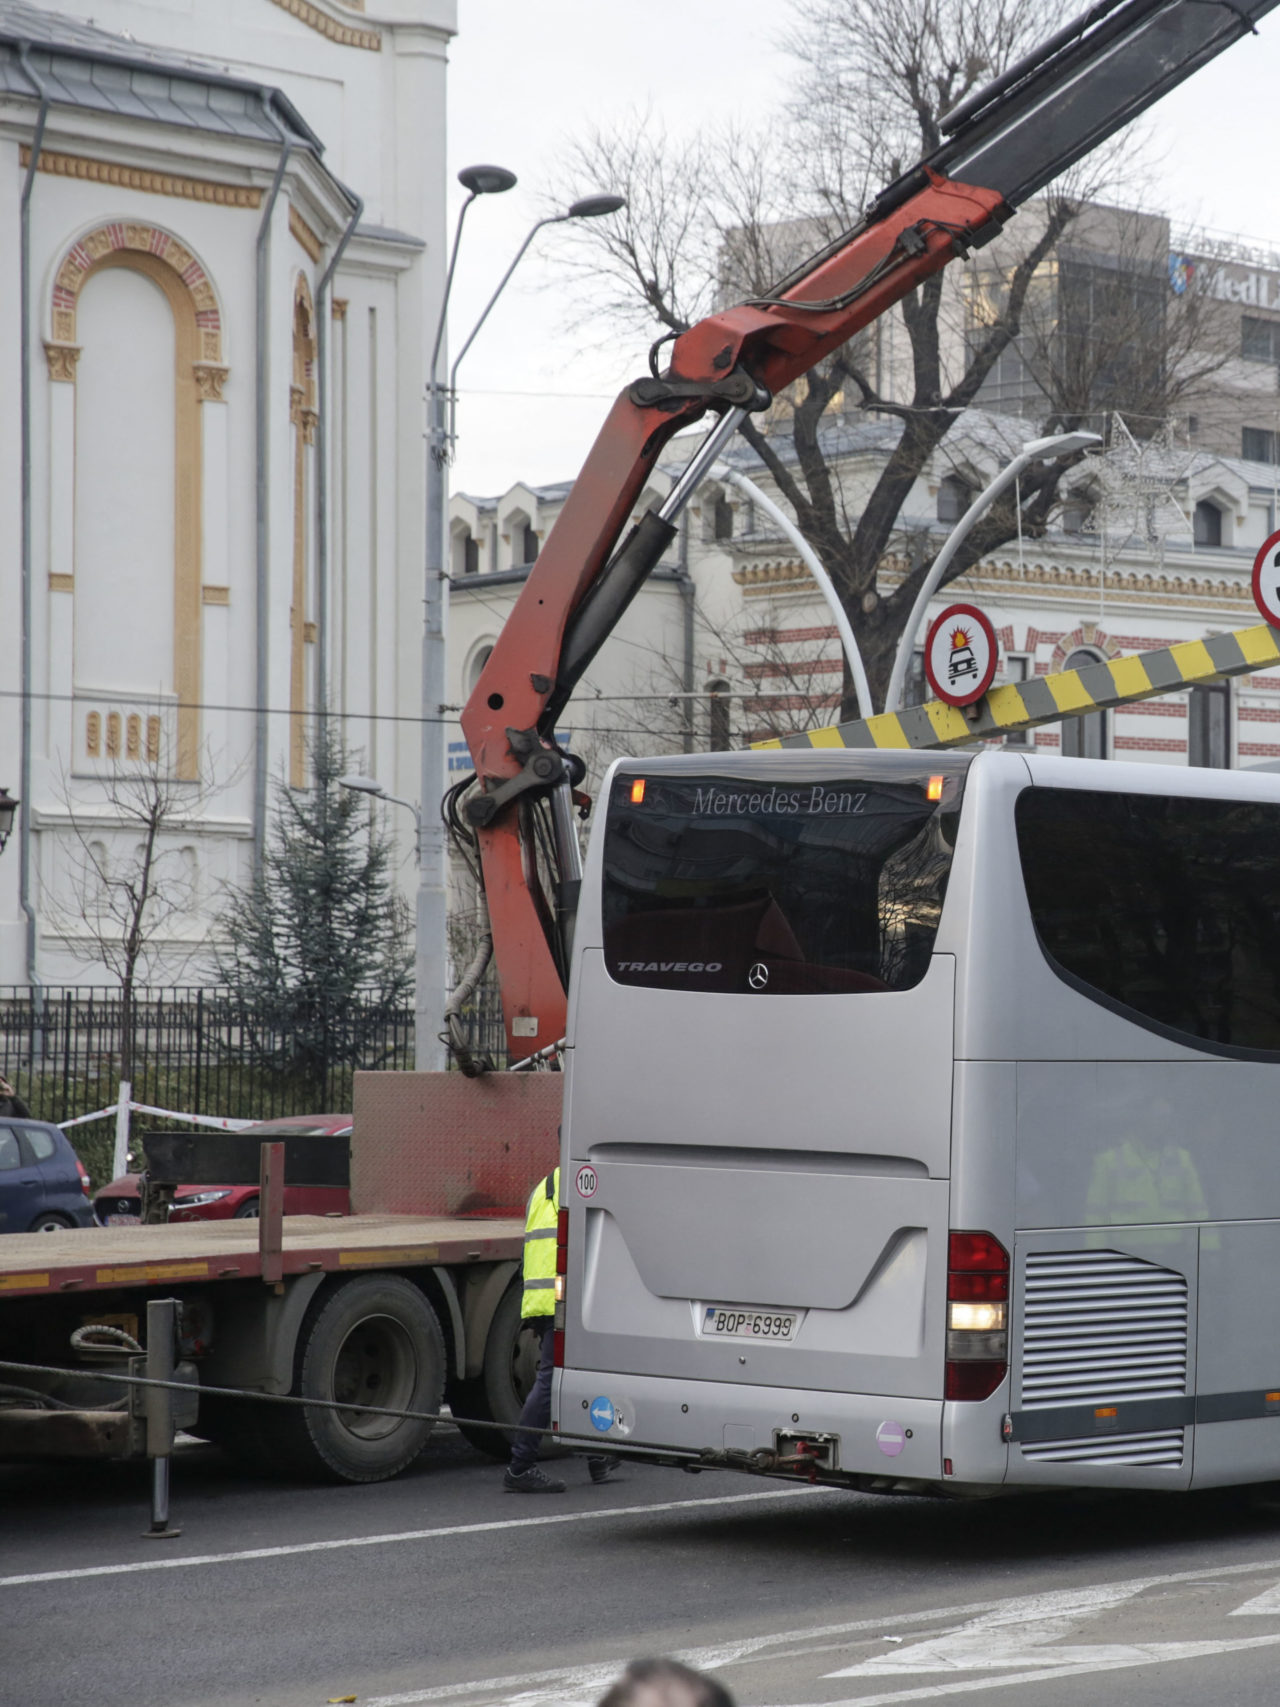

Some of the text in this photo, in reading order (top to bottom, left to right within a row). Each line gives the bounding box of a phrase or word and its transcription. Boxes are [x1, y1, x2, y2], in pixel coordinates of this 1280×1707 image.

[692, 786, 867, 815] Mercedes-Benz
[617, 961, 723, 974] TRAVEGO
[579, 1174, 595, 1190] 100
